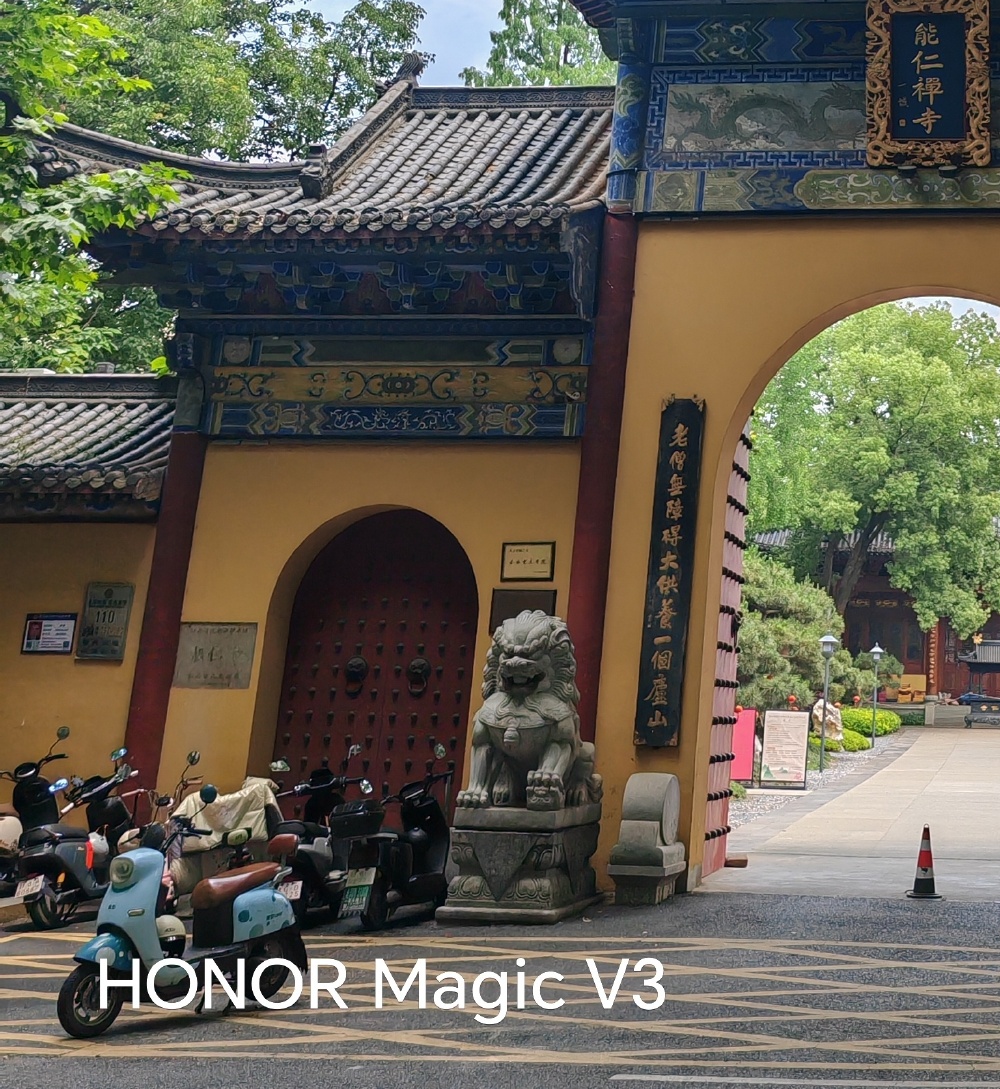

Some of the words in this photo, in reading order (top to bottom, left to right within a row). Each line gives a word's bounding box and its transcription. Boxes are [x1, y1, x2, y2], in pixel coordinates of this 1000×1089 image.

[911, 23, 944, 134] 能仁禪寺
[96, 610, 116, 624] 110
